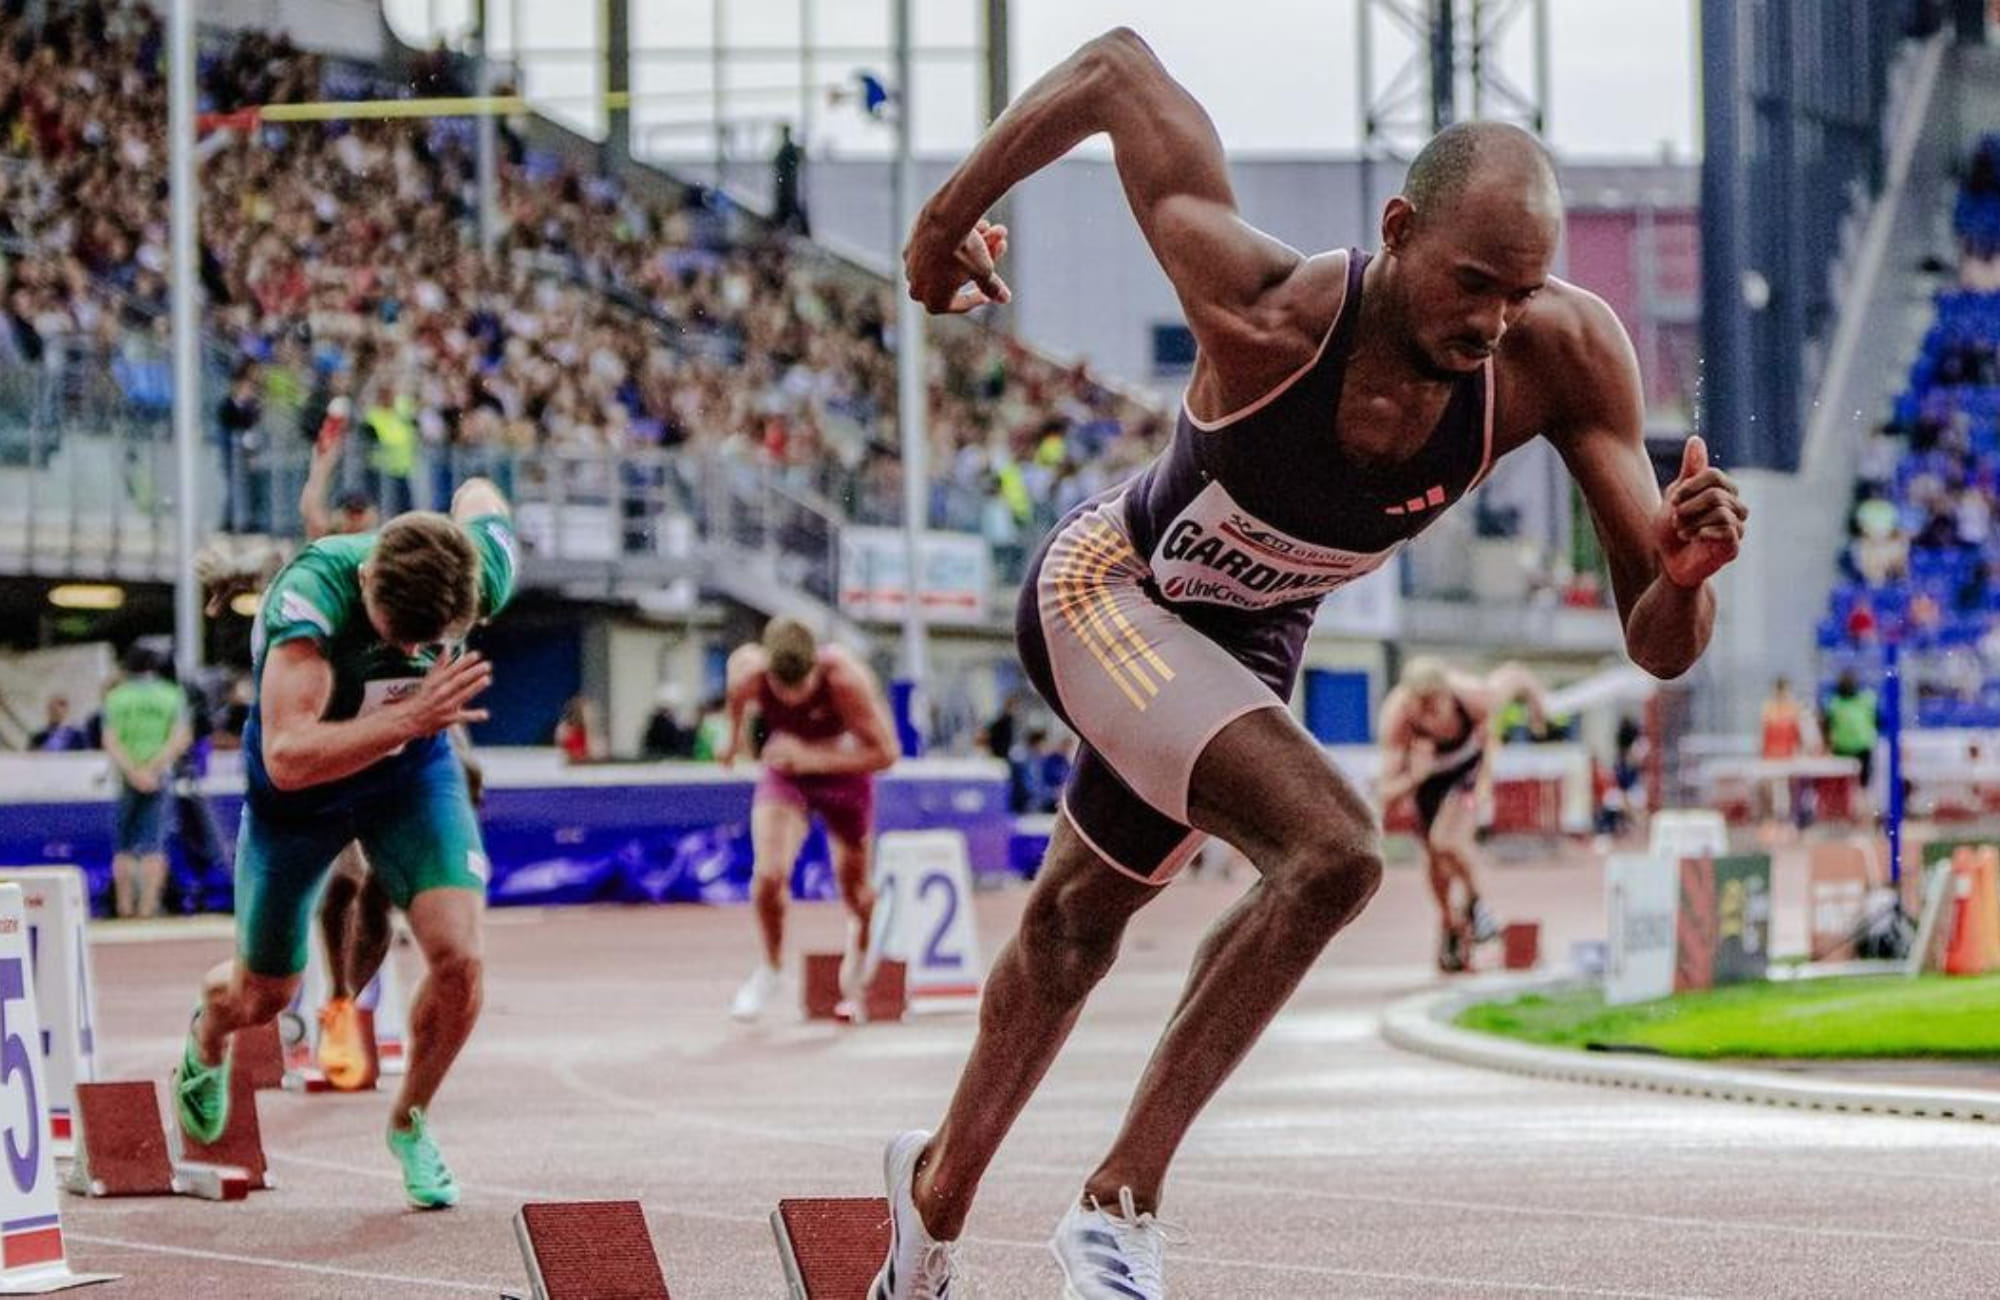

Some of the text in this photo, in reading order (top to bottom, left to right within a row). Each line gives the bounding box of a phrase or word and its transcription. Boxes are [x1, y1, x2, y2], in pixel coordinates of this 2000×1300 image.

[1162, 519, 1372, 595] GARDINE
[917, 872, 962, 967] 2
[0, 957, 40, 1195] 5
